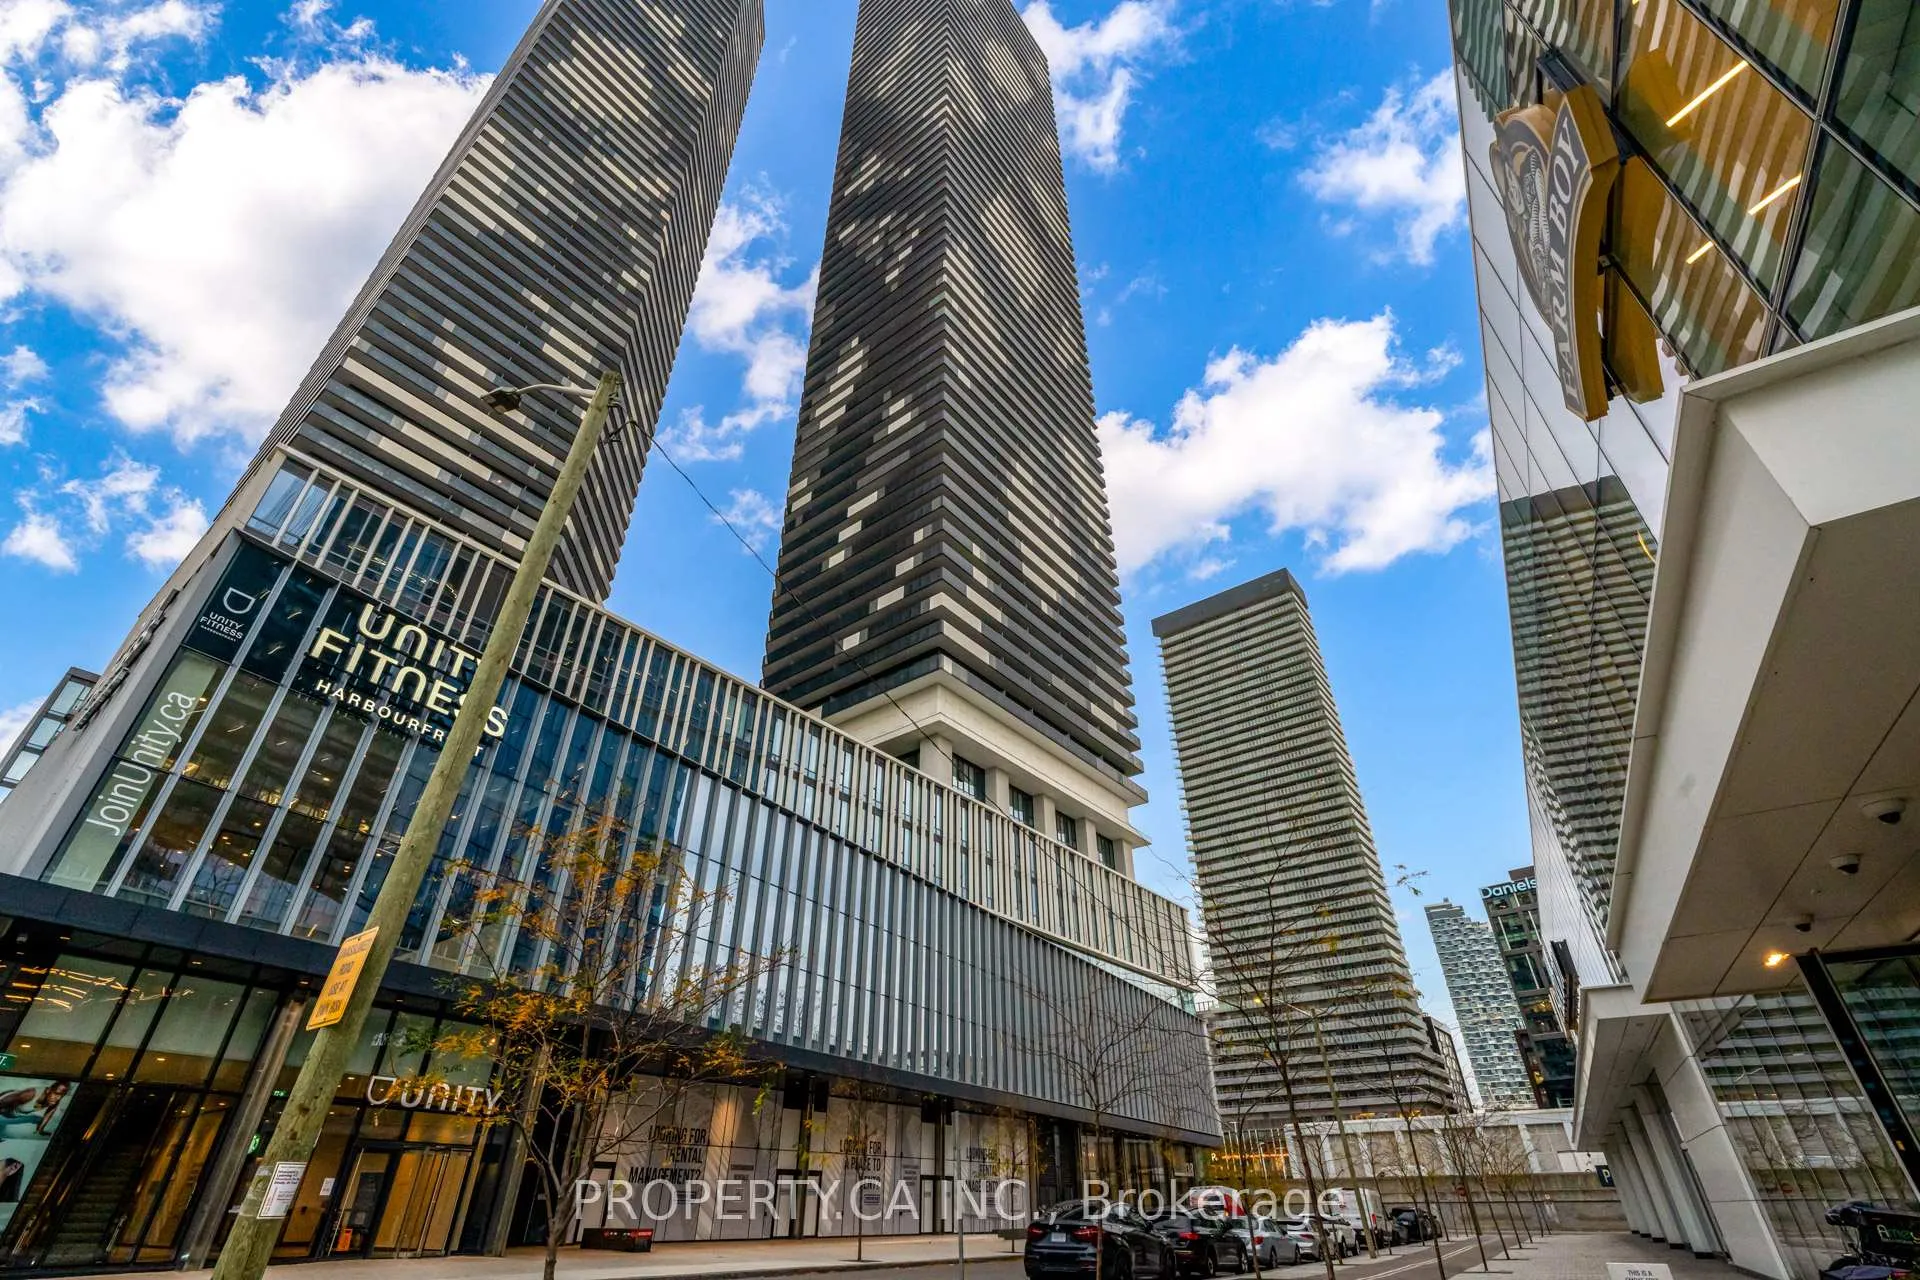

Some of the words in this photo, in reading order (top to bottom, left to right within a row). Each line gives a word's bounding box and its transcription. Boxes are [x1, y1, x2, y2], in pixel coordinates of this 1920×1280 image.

[1550, 116, 1579, 243] BOY
[1550, 247, 1578, 398] FARM
[200, 616, 244, 639] FITNESS
[209, 612, 245, 630] UNITY
[358, 603, 482, 679] UNIT
[310, 627, 509, 737] FITNES
[316, 679, 484, 757] HARBOURFRT
[86, 691, 196, 837] JoinUnity.ca
[1480, 877, 1536, 899] Daniels
